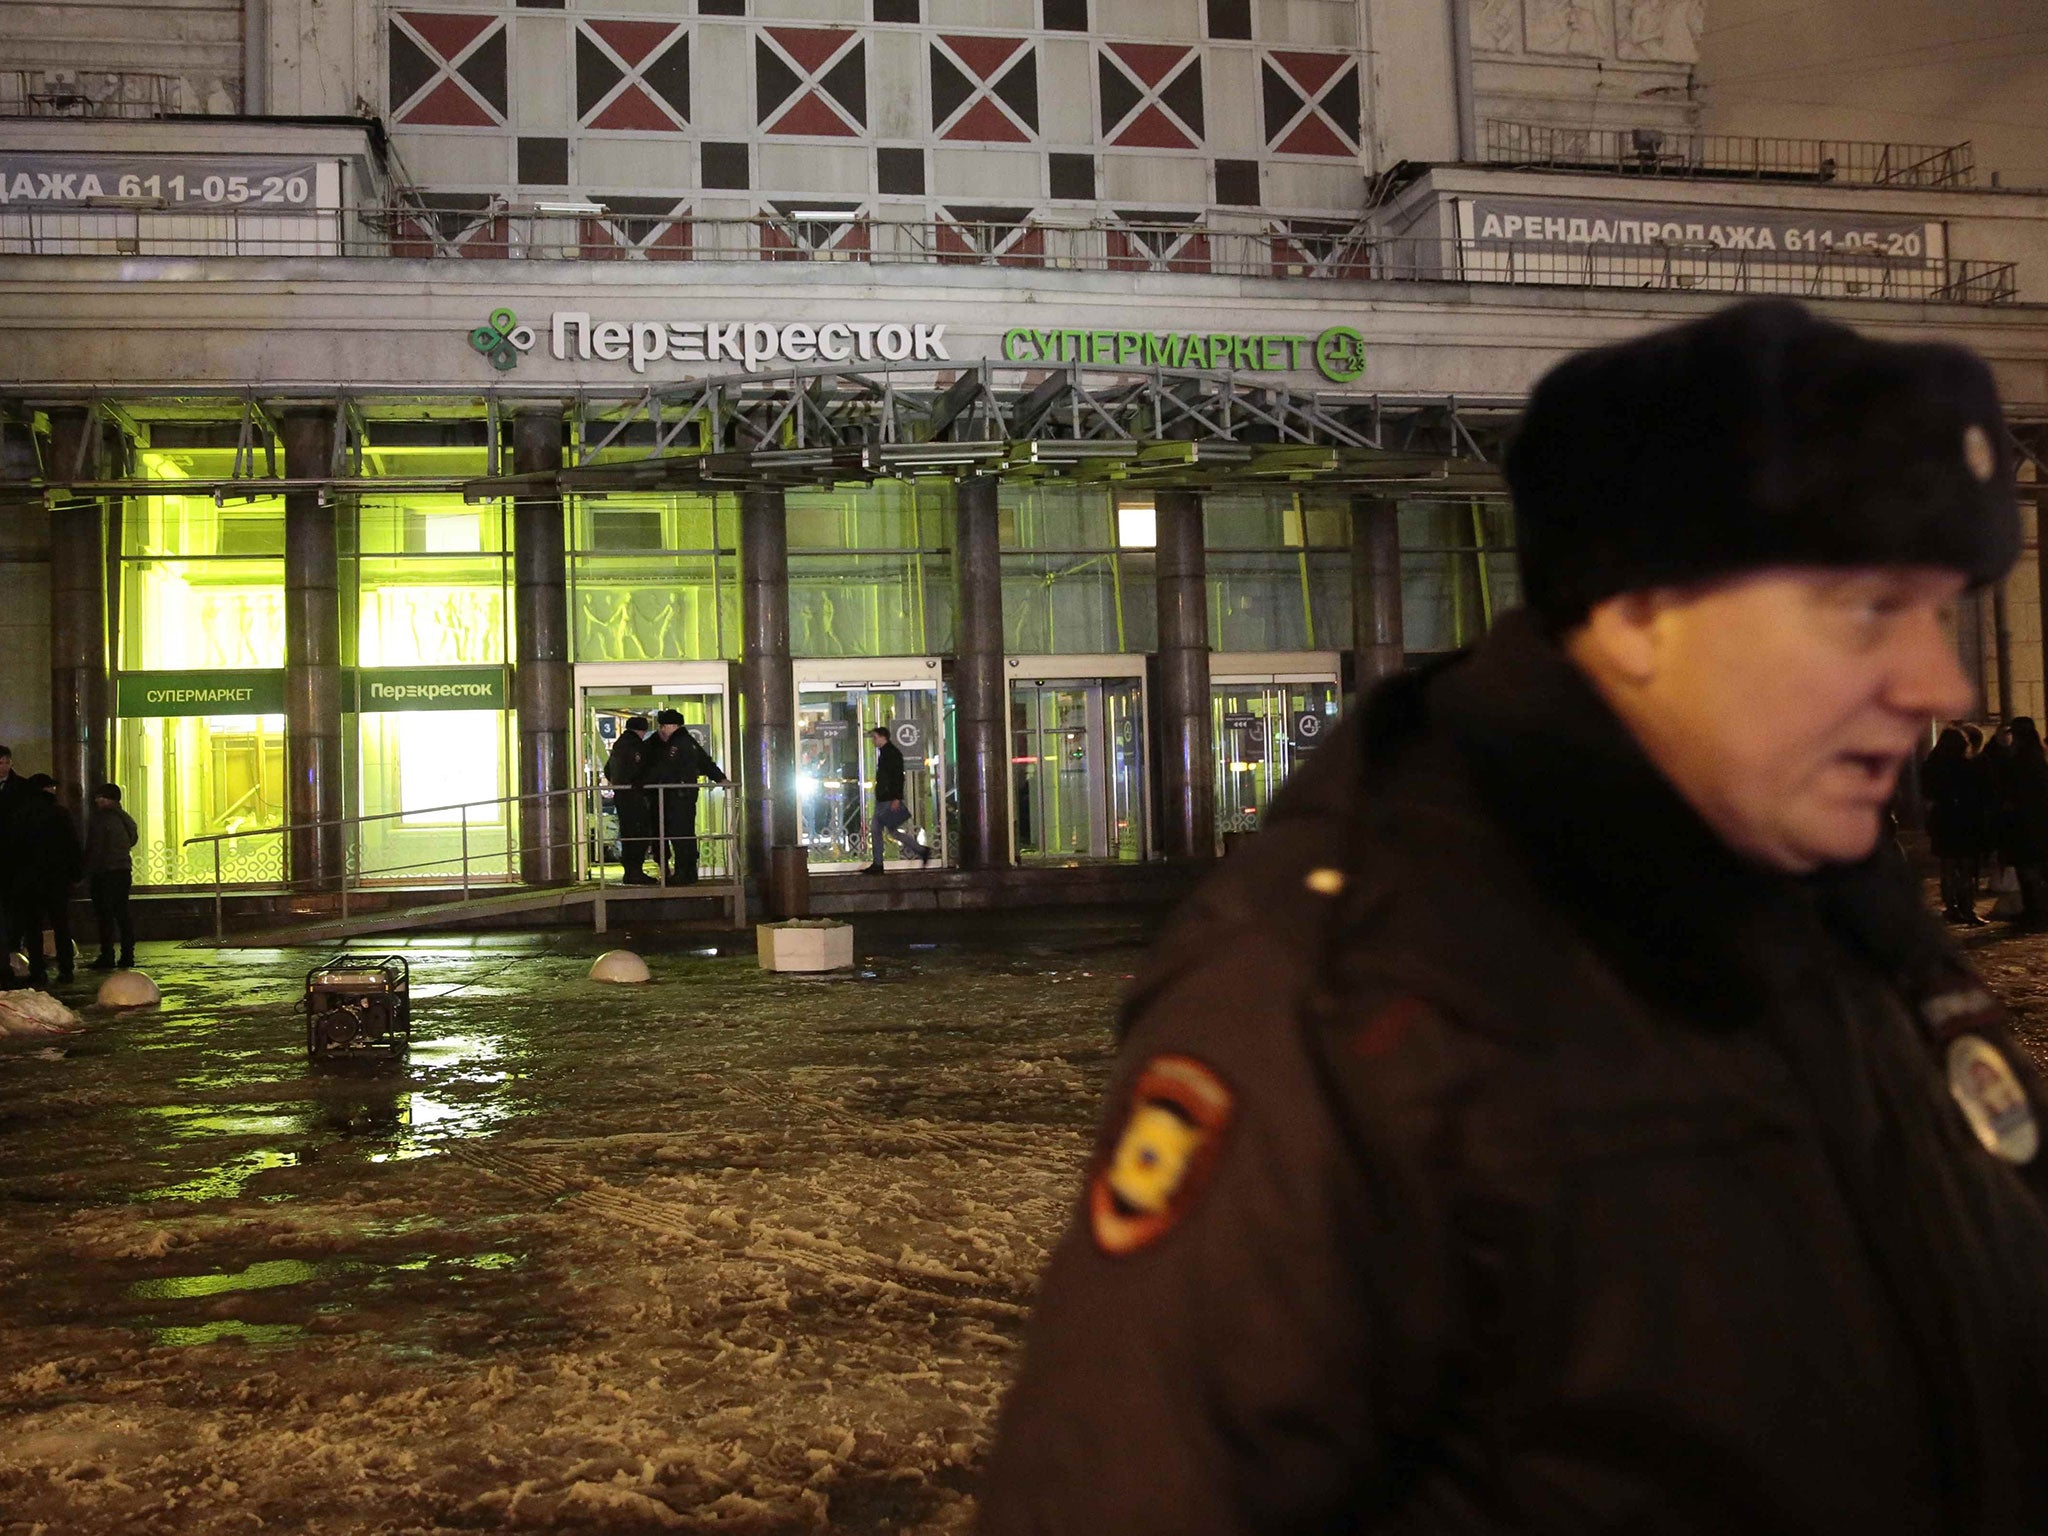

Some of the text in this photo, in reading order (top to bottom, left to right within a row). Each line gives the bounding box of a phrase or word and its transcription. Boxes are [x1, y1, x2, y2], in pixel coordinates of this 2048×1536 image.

[0, 173, 308, 203] АЖА 611-05-20
[1481, 213, 1776, 251] АРЕНДА/ПРОДАЖА
[1004, 328, 1306, 371] СУПЕРМАРКЕТ
[147, 688, 254, 703] СУПЕРМАРКЕТ
